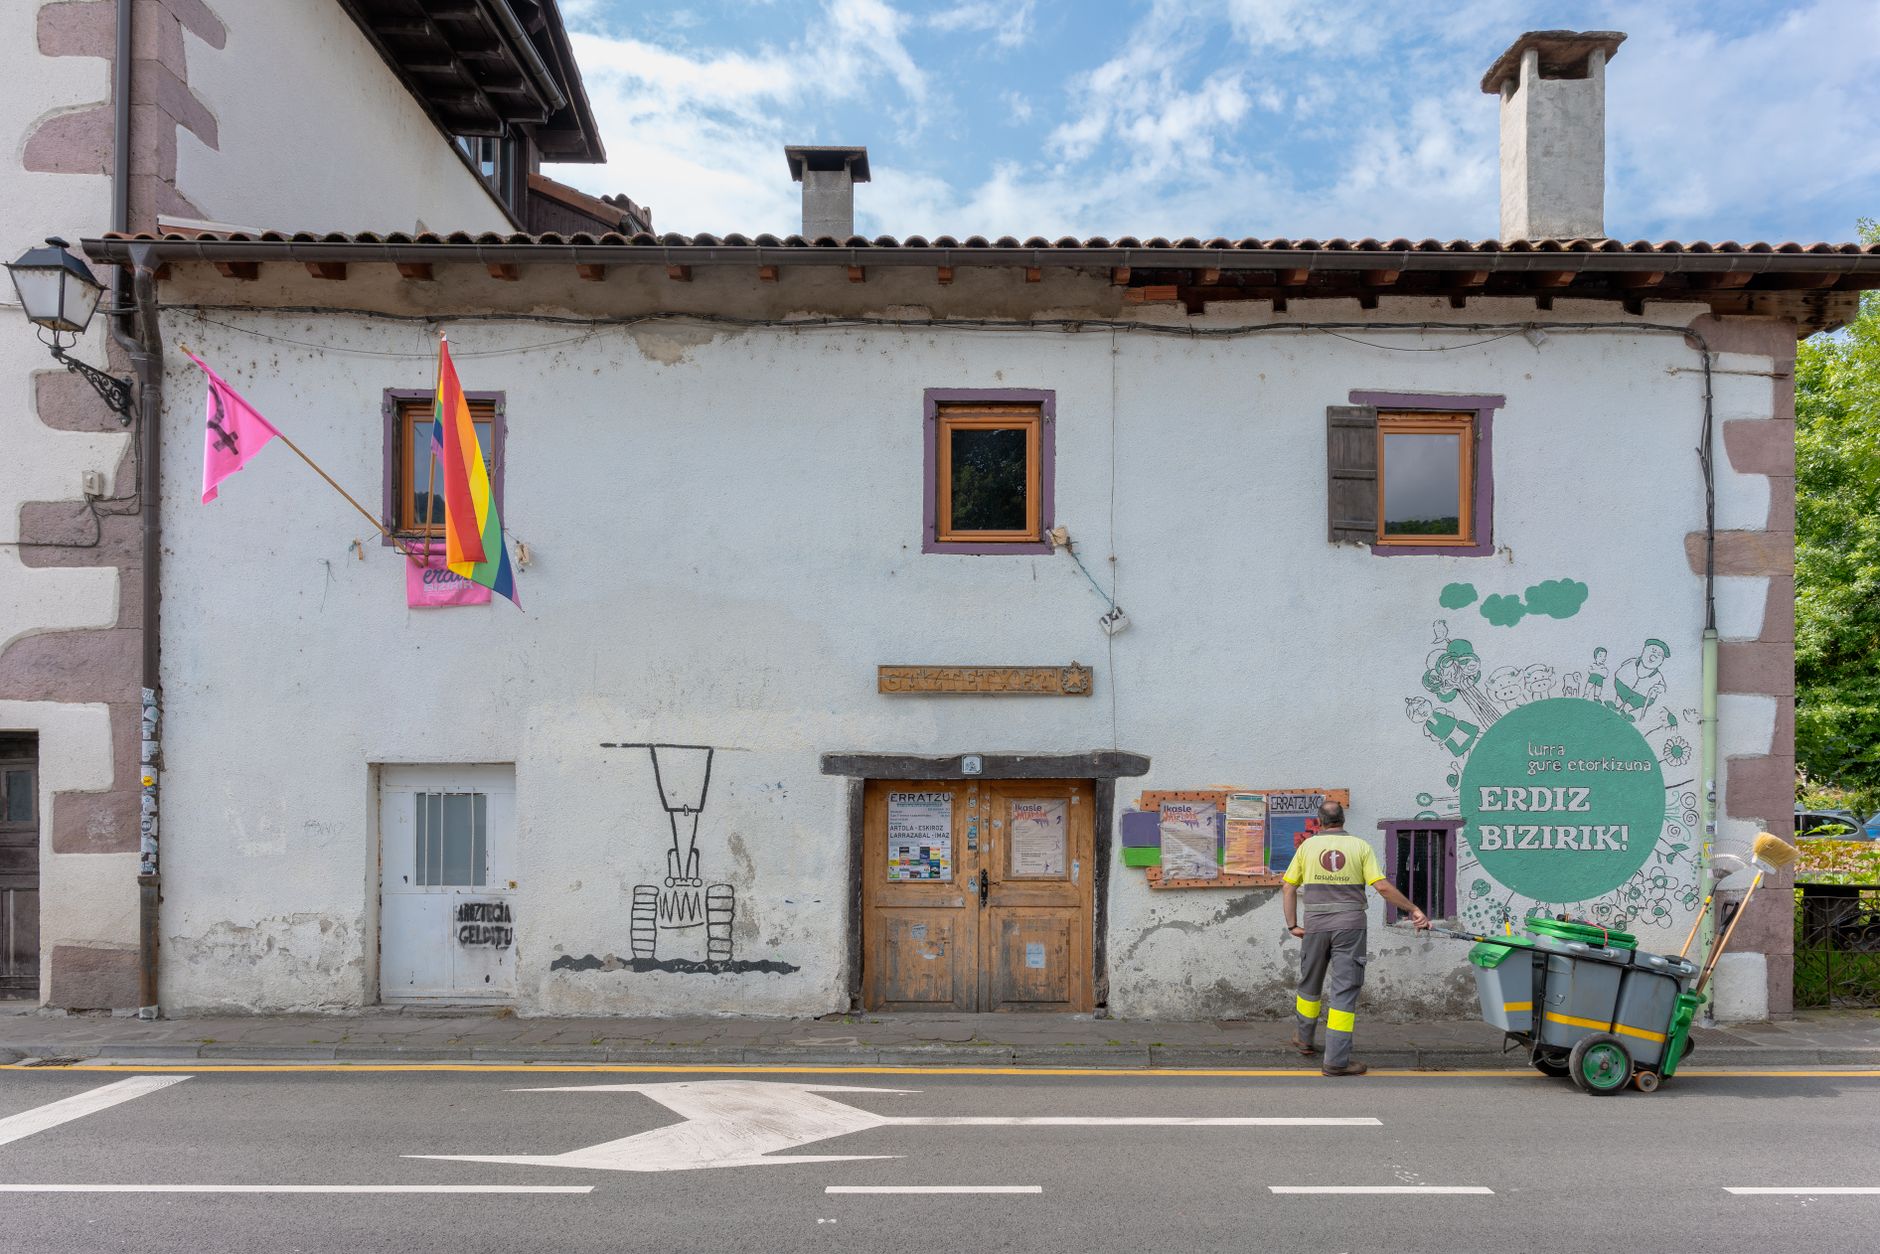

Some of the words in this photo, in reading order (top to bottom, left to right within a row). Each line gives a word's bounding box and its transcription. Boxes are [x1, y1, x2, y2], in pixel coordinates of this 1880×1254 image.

[1527, 759, 1562, 776] gure
[1567, 757, 1652, 772] etorkizuna
[890, 793, 951, 802] ERRATZU
[1478, 786, 1591, 812] ERDIZ
[1015, 803, 1042, 812] Ikasle
[1163, 805, 1192, 813] Ikasle
[1478, 824, 1629, 851] BIZIRIK!
